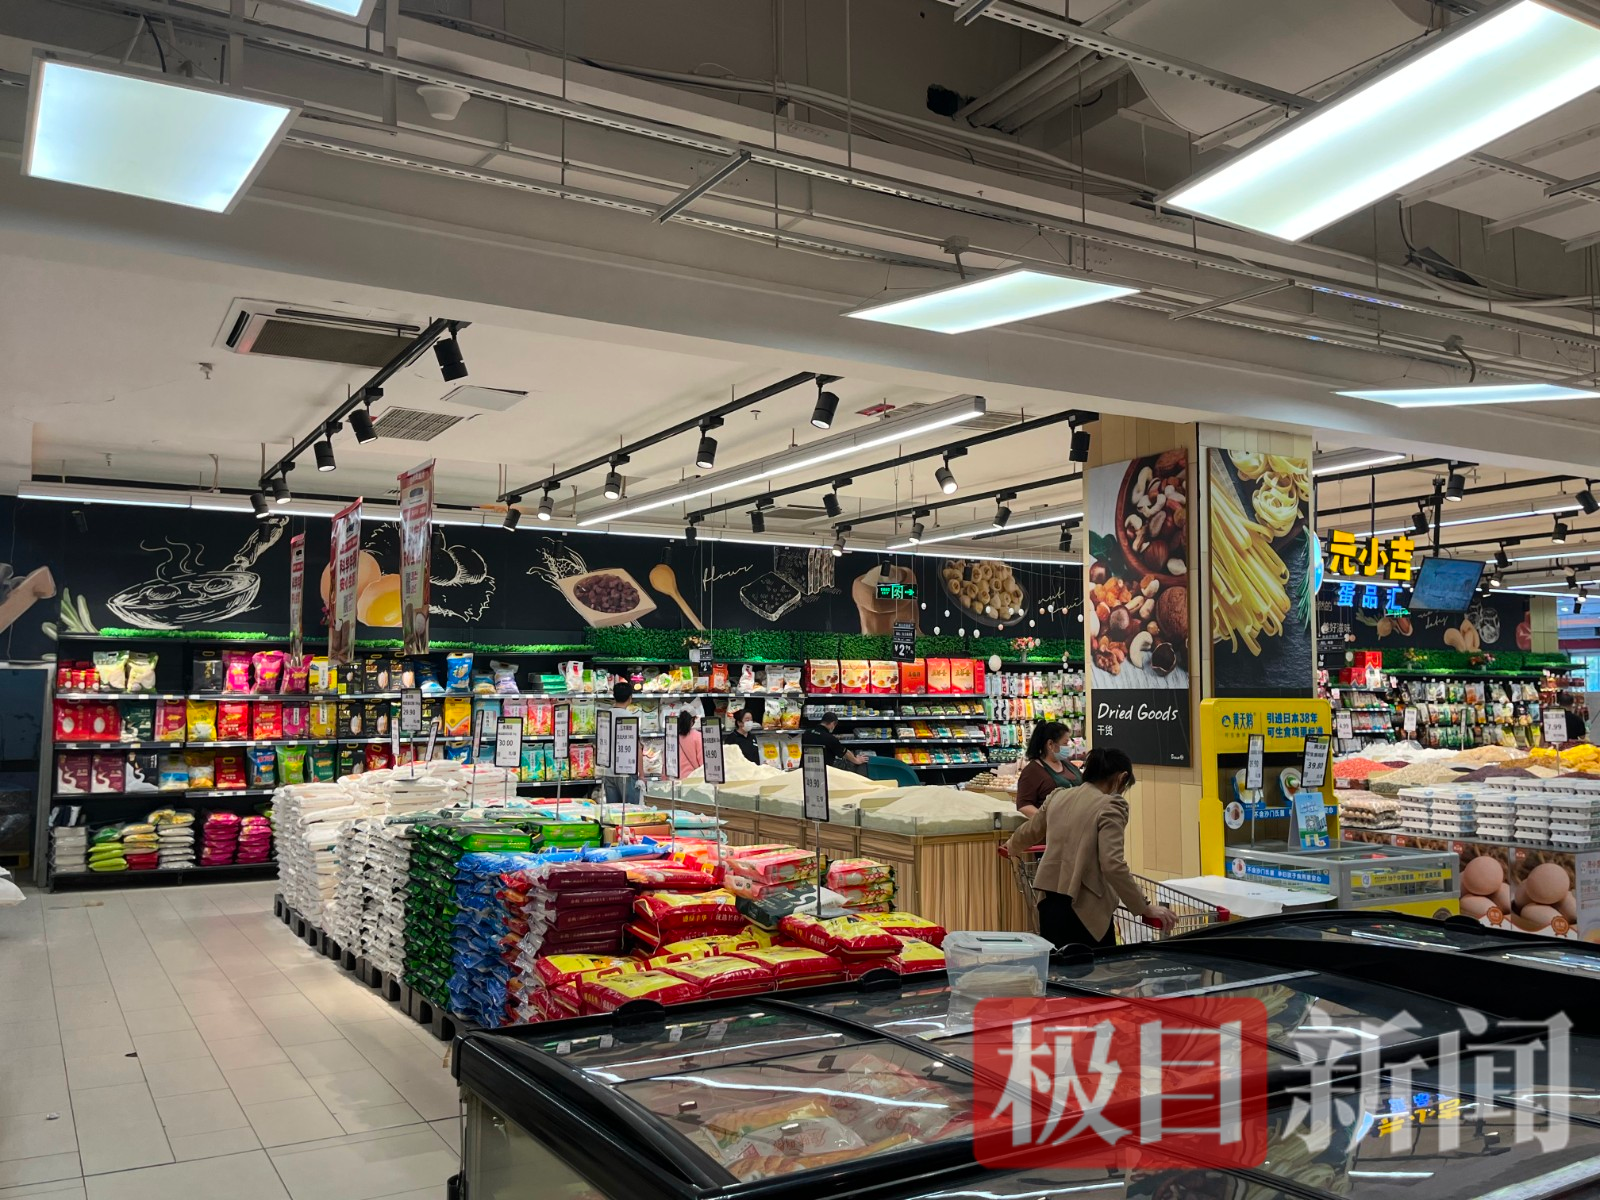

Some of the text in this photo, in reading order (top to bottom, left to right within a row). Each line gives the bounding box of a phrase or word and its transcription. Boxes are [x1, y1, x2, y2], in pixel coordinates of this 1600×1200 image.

[1330, 530, 1414, 581] 元小吉
[1337, 582, 1404, 610] 蛋品汇
[1097, 702, 1179, 722] Dried Goods
[1266, 712, 1319, 724] 引进日本38年
[1097, 724, 1114, 736] 干货
